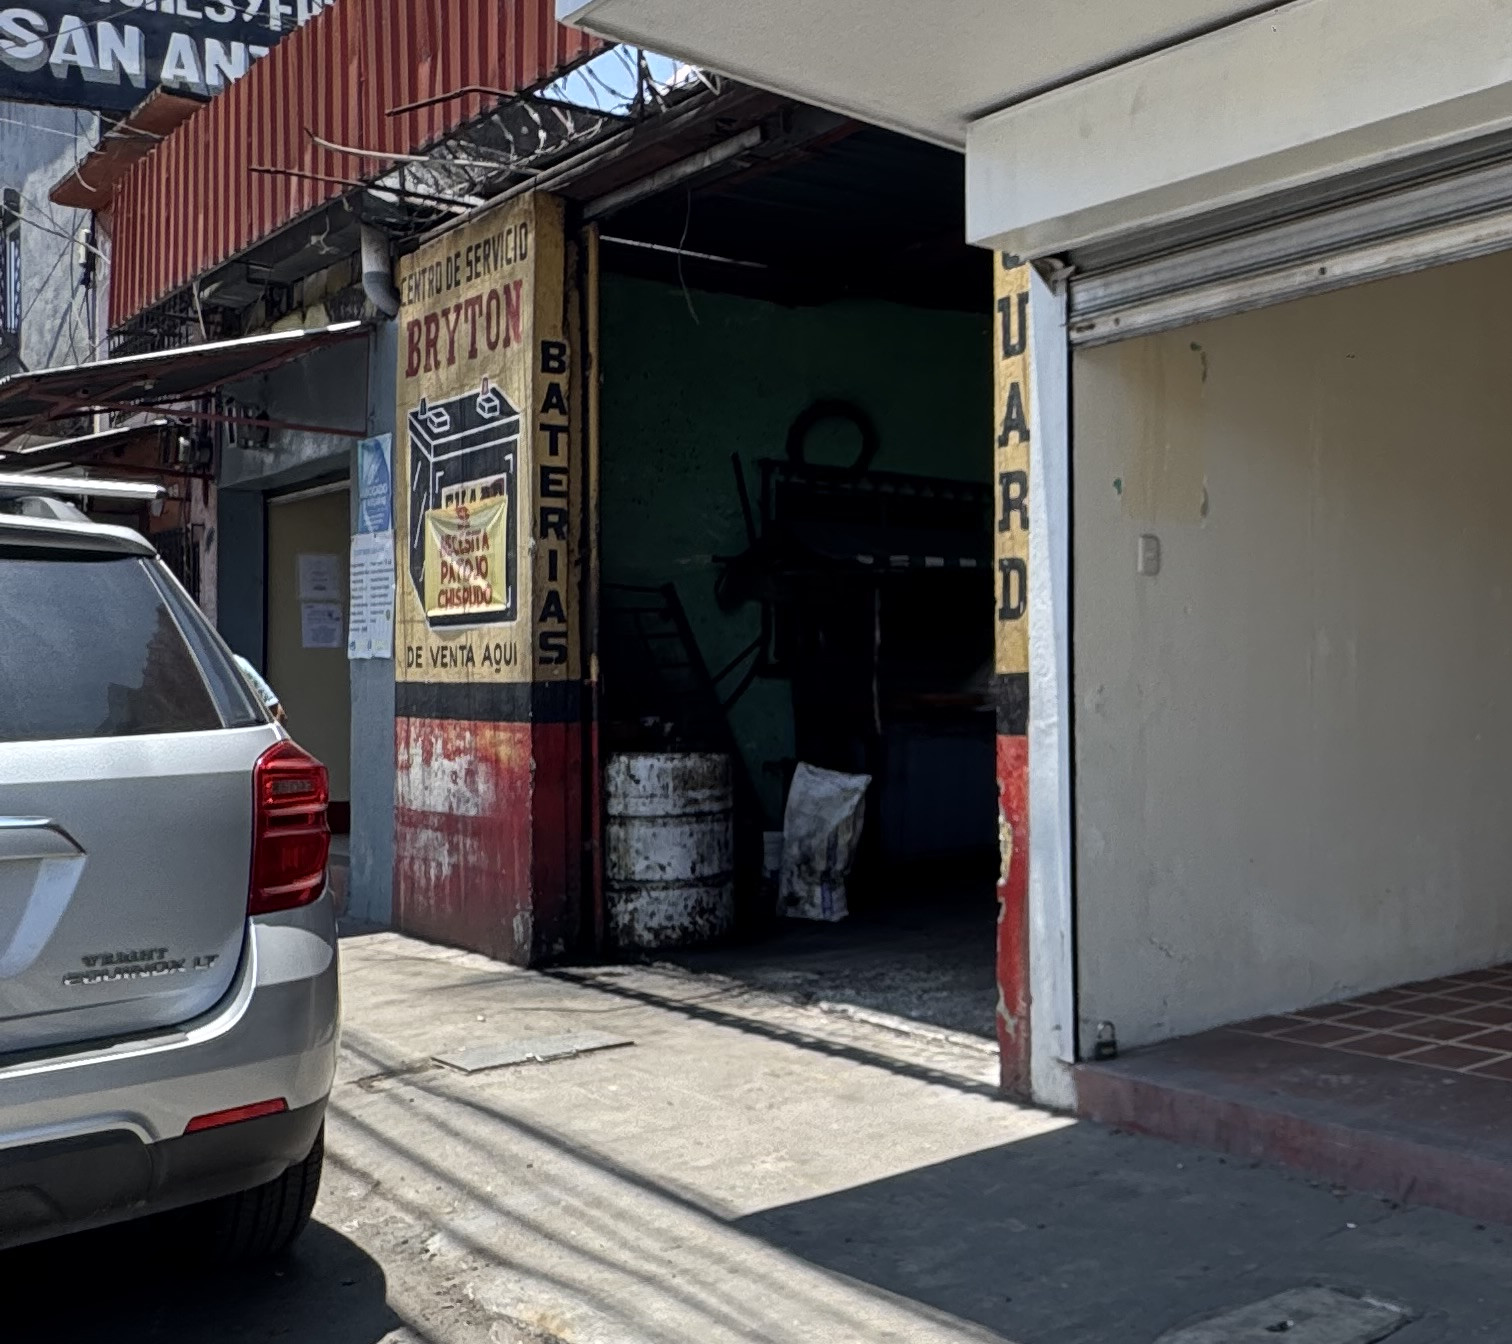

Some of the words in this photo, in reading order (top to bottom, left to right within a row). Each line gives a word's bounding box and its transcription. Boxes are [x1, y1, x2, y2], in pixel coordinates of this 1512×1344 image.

[0, 7, 144, 80] SAN
[401, 261, 443, 307] CENTRO
[446, 250, 461, 291] DE
[466, 221, 528, 283] SERVICIO
[405, 278, 523, 378] BRYTON
[539, 340, 569, 665] BATERIAS
[406, 644, 423, 668] DE
[429, 643, 476, 668] VENTA
[481, 641, 518, 673] AQUI
